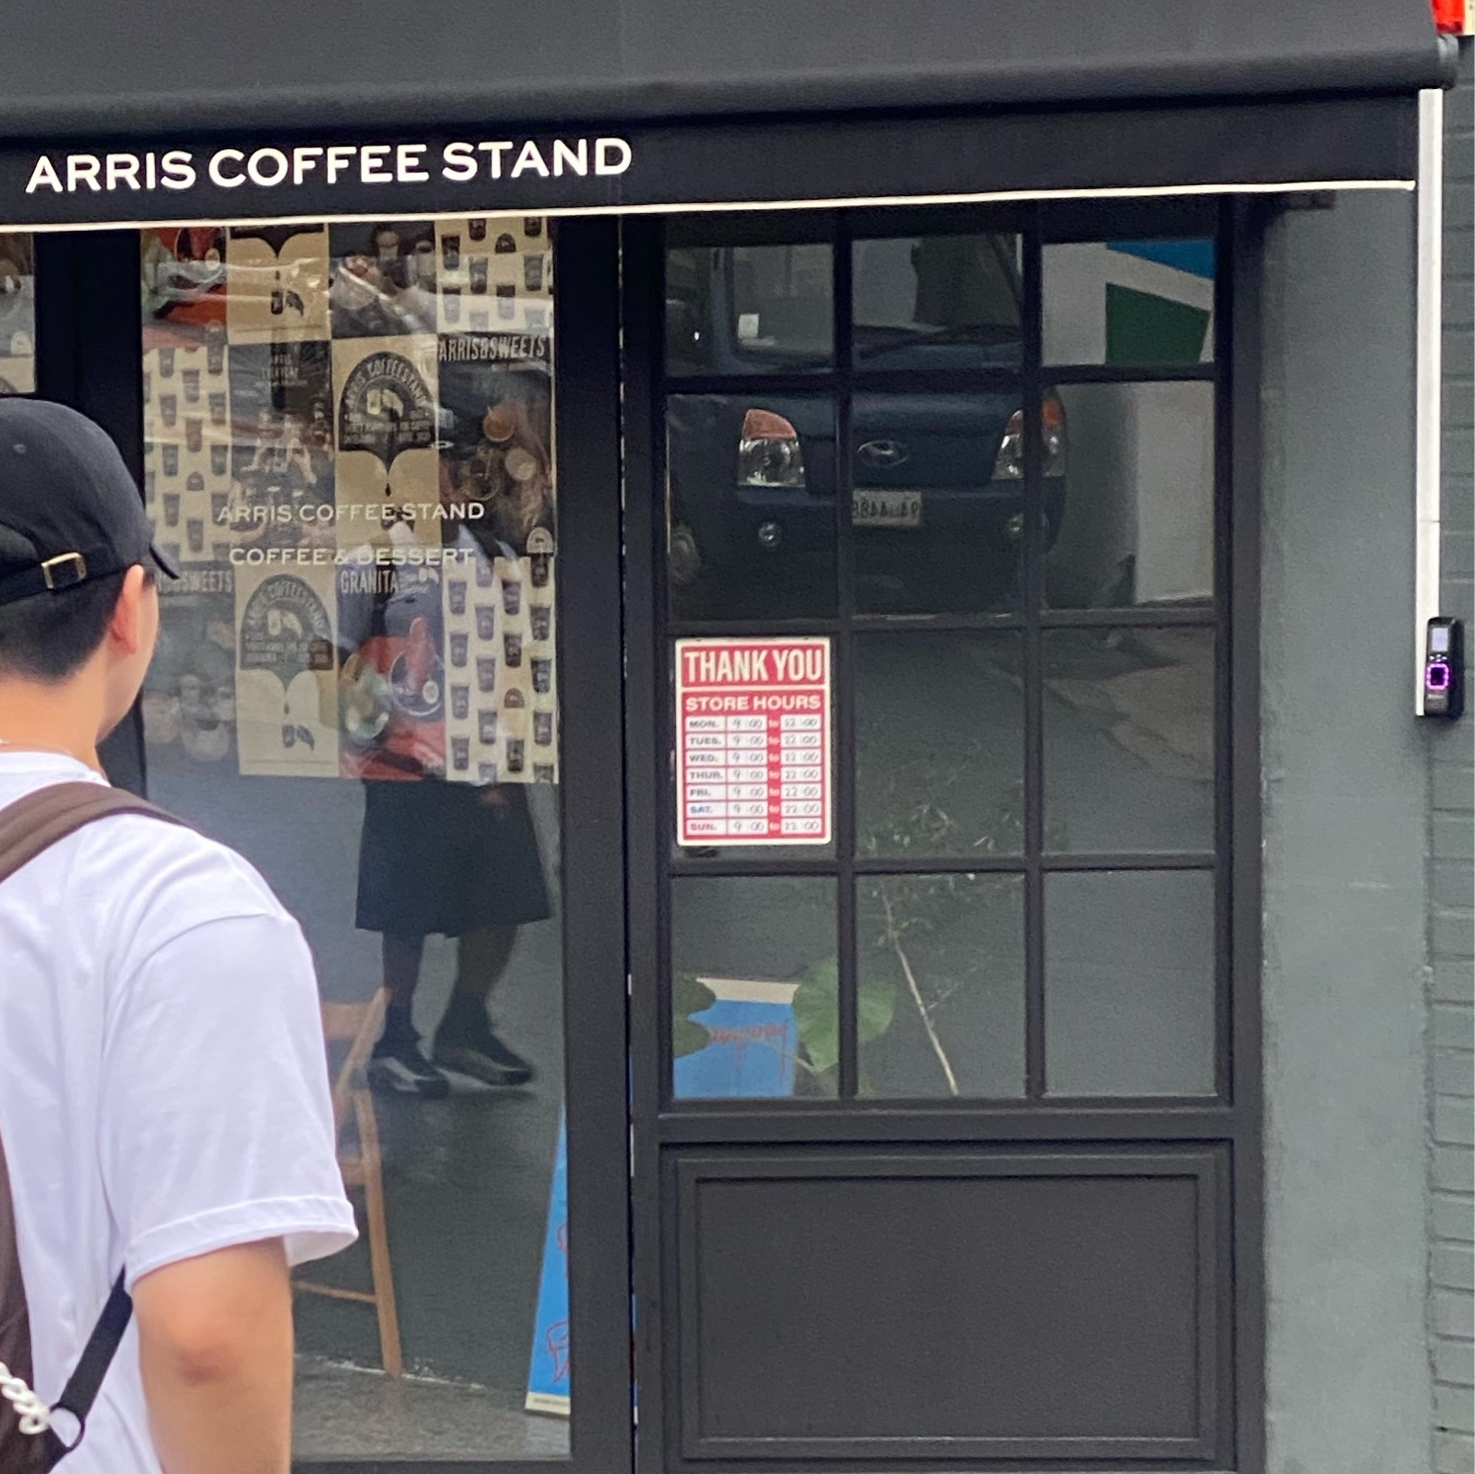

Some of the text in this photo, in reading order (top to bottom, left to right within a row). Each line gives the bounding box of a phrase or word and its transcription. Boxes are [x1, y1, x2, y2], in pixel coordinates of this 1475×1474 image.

[25, 138, 633, 194] ARRIS COFFEE STAND
[217, 502, 485, 522] ARRIS COFFEE STAND
[228, 548, 476, 565] COFFEE & DESSERT
[341, 569, 398, 593] GRANITA
[684, 648, 822, 682] THANK YOU
[685, 695, 822, 711] STORE HOURS
